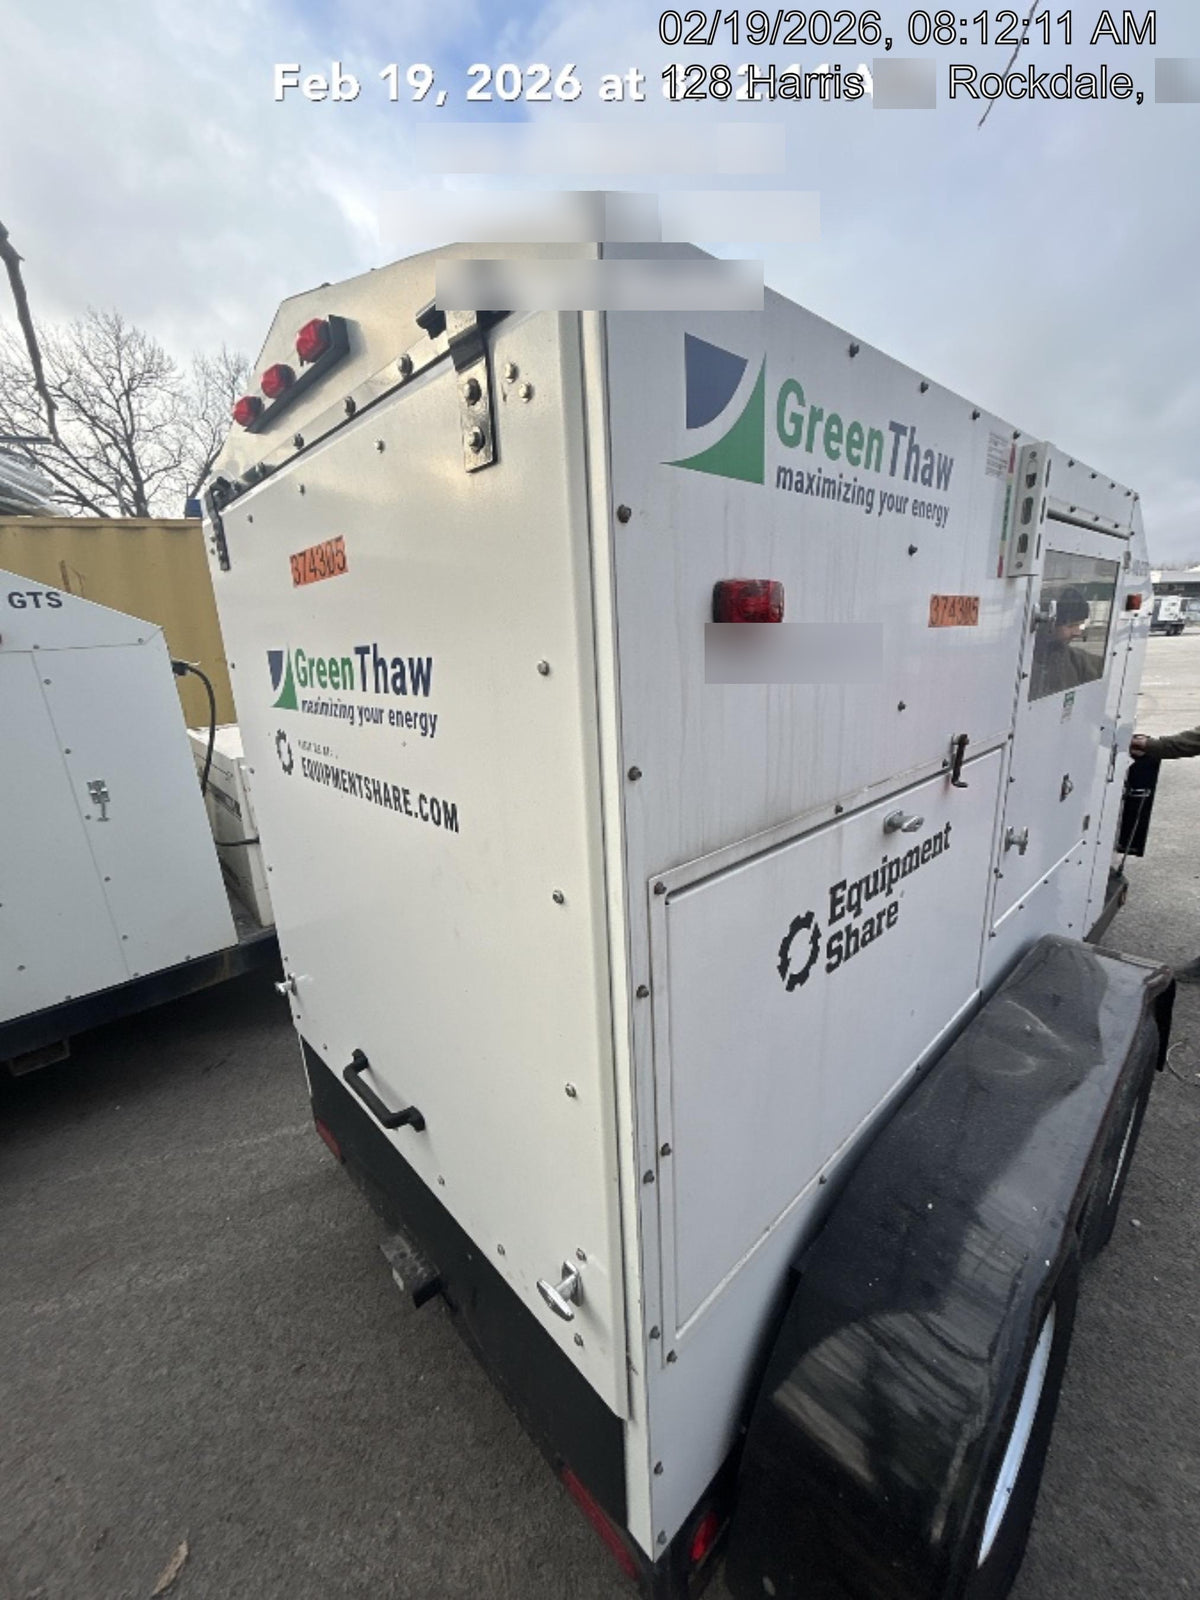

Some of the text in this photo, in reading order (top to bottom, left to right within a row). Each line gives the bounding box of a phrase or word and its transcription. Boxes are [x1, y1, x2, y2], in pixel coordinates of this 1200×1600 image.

[775, 463, 951, 529] maximizing your energy
[7, 591, 63, 609] GTS
[357, 704, 385, 727] your
[388, 708, 438, 739] energy
[301, 756, 460, 834] EQUIPMENTSHARE.COM
[827, 821, 953, 927] Equipment
[825, 900, 899, 975] Share
